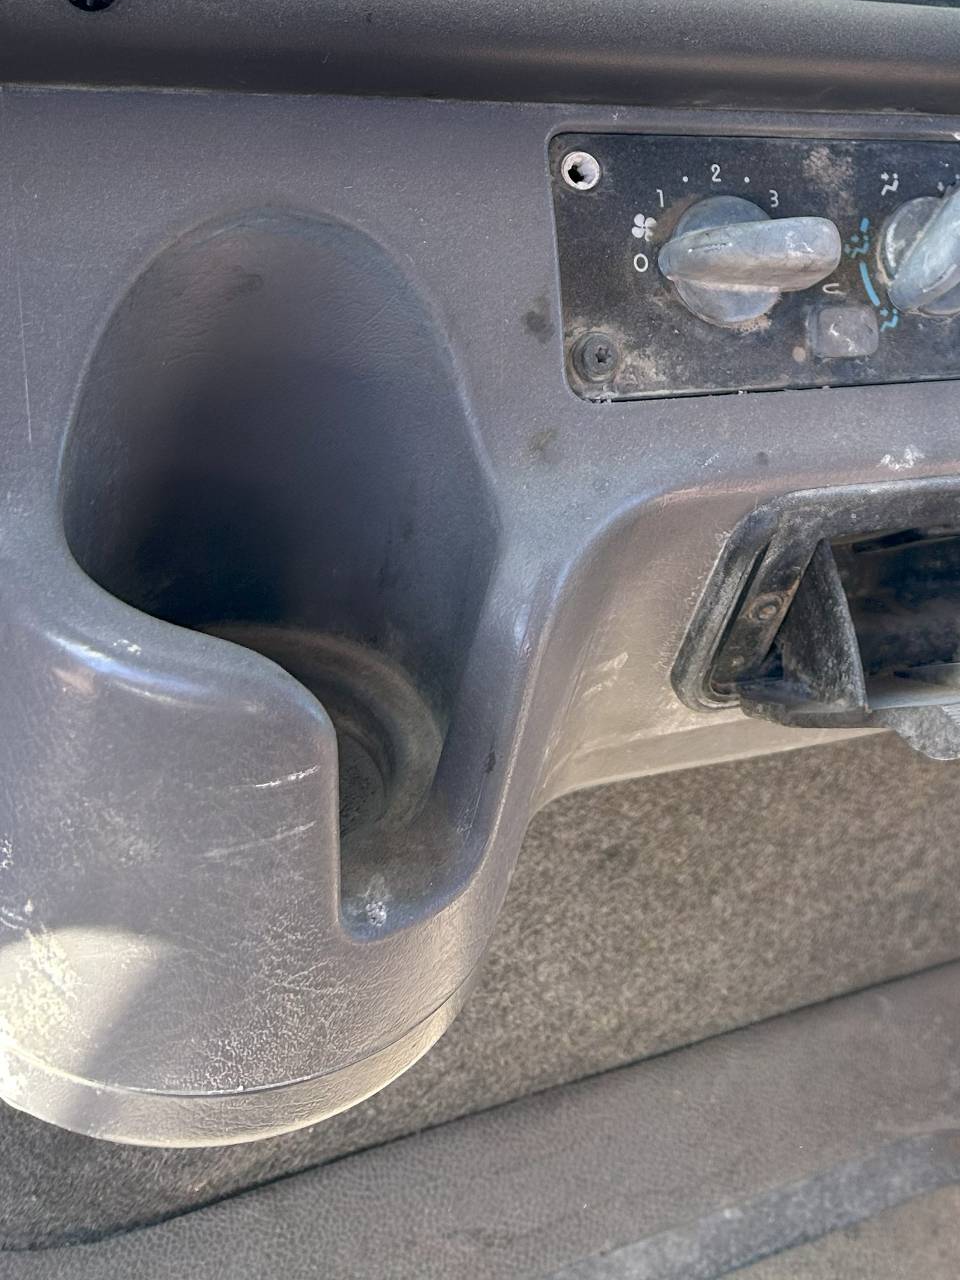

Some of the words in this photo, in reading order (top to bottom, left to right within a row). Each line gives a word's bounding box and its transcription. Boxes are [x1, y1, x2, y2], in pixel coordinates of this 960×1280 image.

[711, 163, 722, 183] 2
[656, 188, 665, 208] 1
[769, 189, 780, 208] 3
